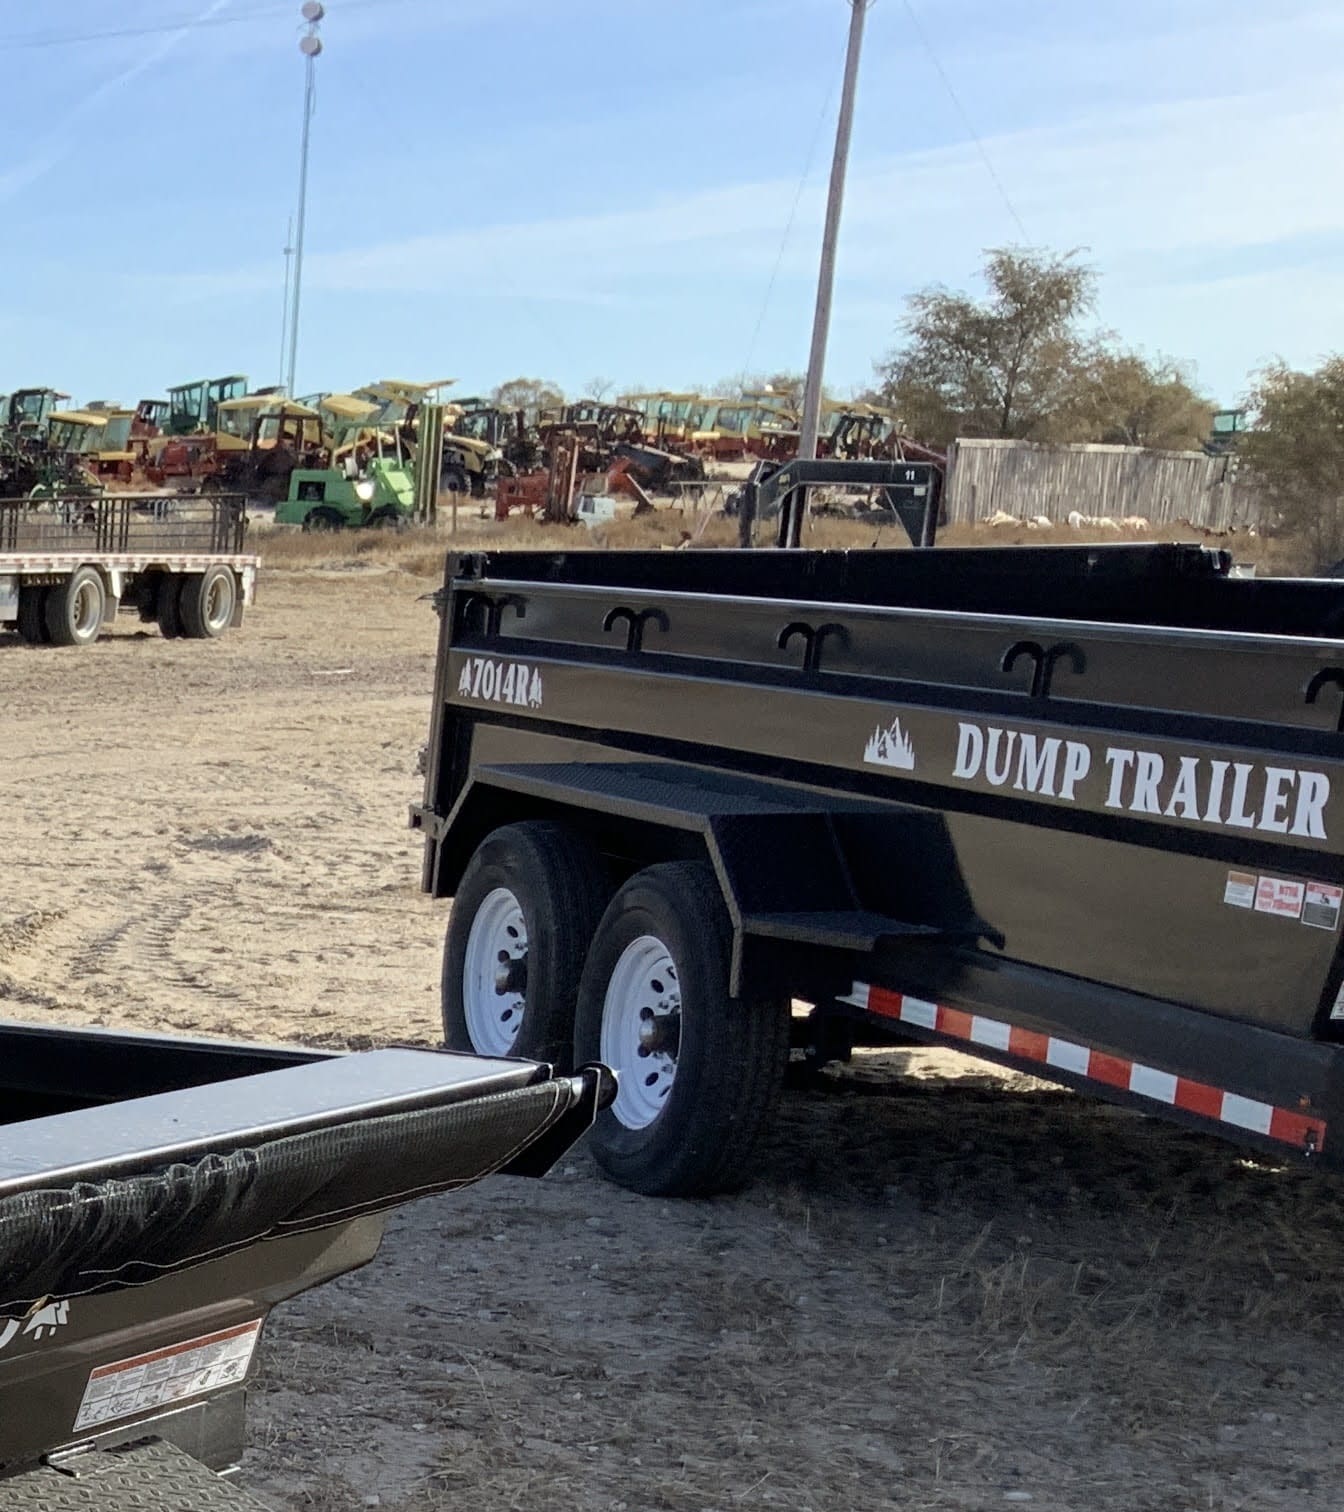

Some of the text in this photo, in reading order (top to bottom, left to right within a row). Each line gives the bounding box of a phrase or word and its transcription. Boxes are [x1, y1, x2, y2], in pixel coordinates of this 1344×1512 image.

[471, 657, 529, 707] 7014R
[952, 721, 1331, 840] DUMP TRAILER
